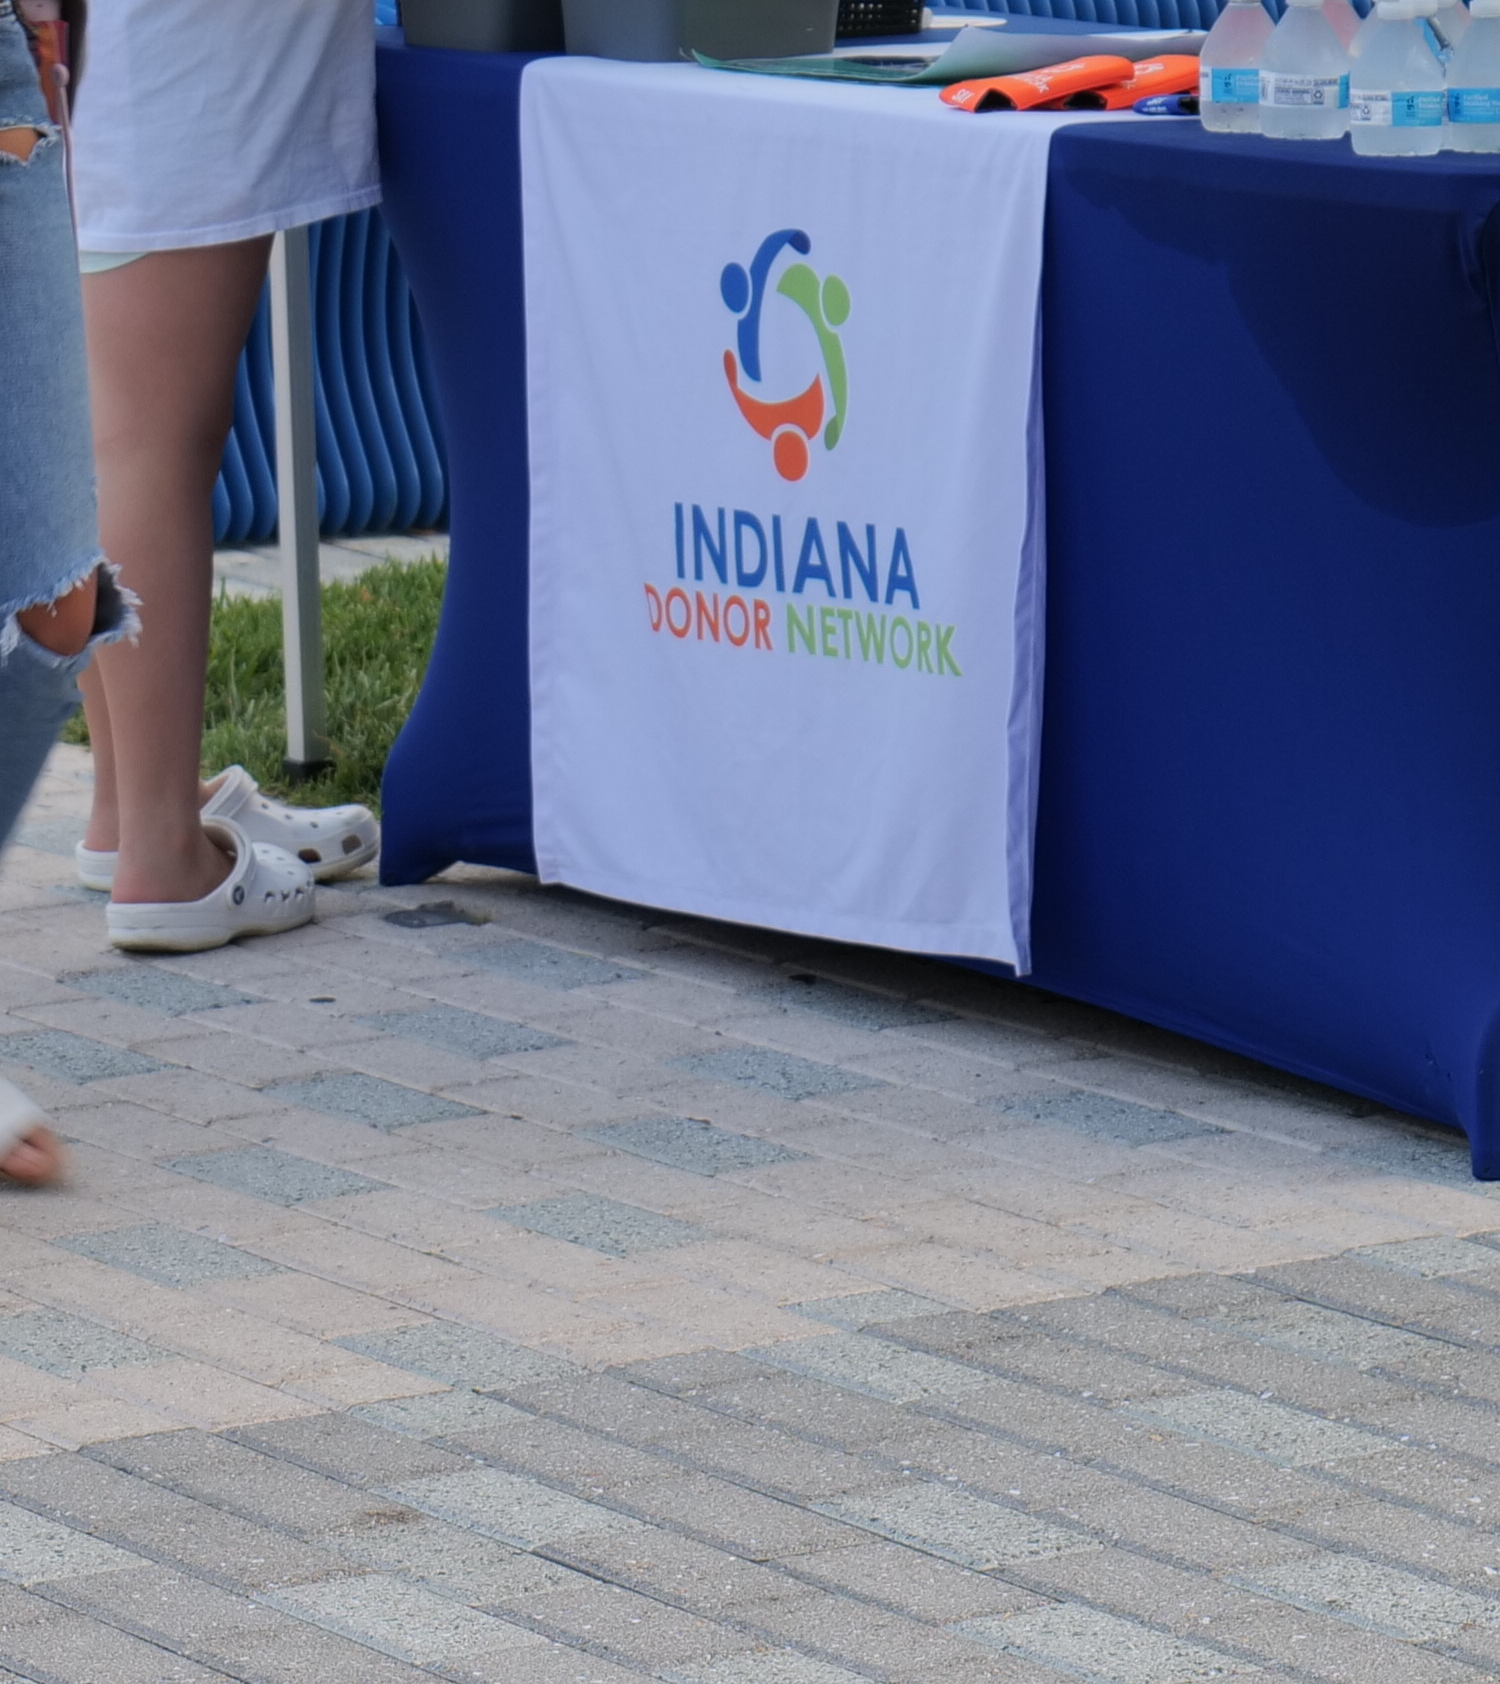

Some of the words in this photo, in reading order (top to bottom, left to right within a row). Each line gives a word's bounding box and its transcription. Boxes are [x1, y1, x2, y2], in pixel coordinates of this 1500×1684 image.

[673, 501, 920, 610] INDIANA
[643, 582, 773, 651] DONOR
[786, 602, 963, 677] NETWORK
